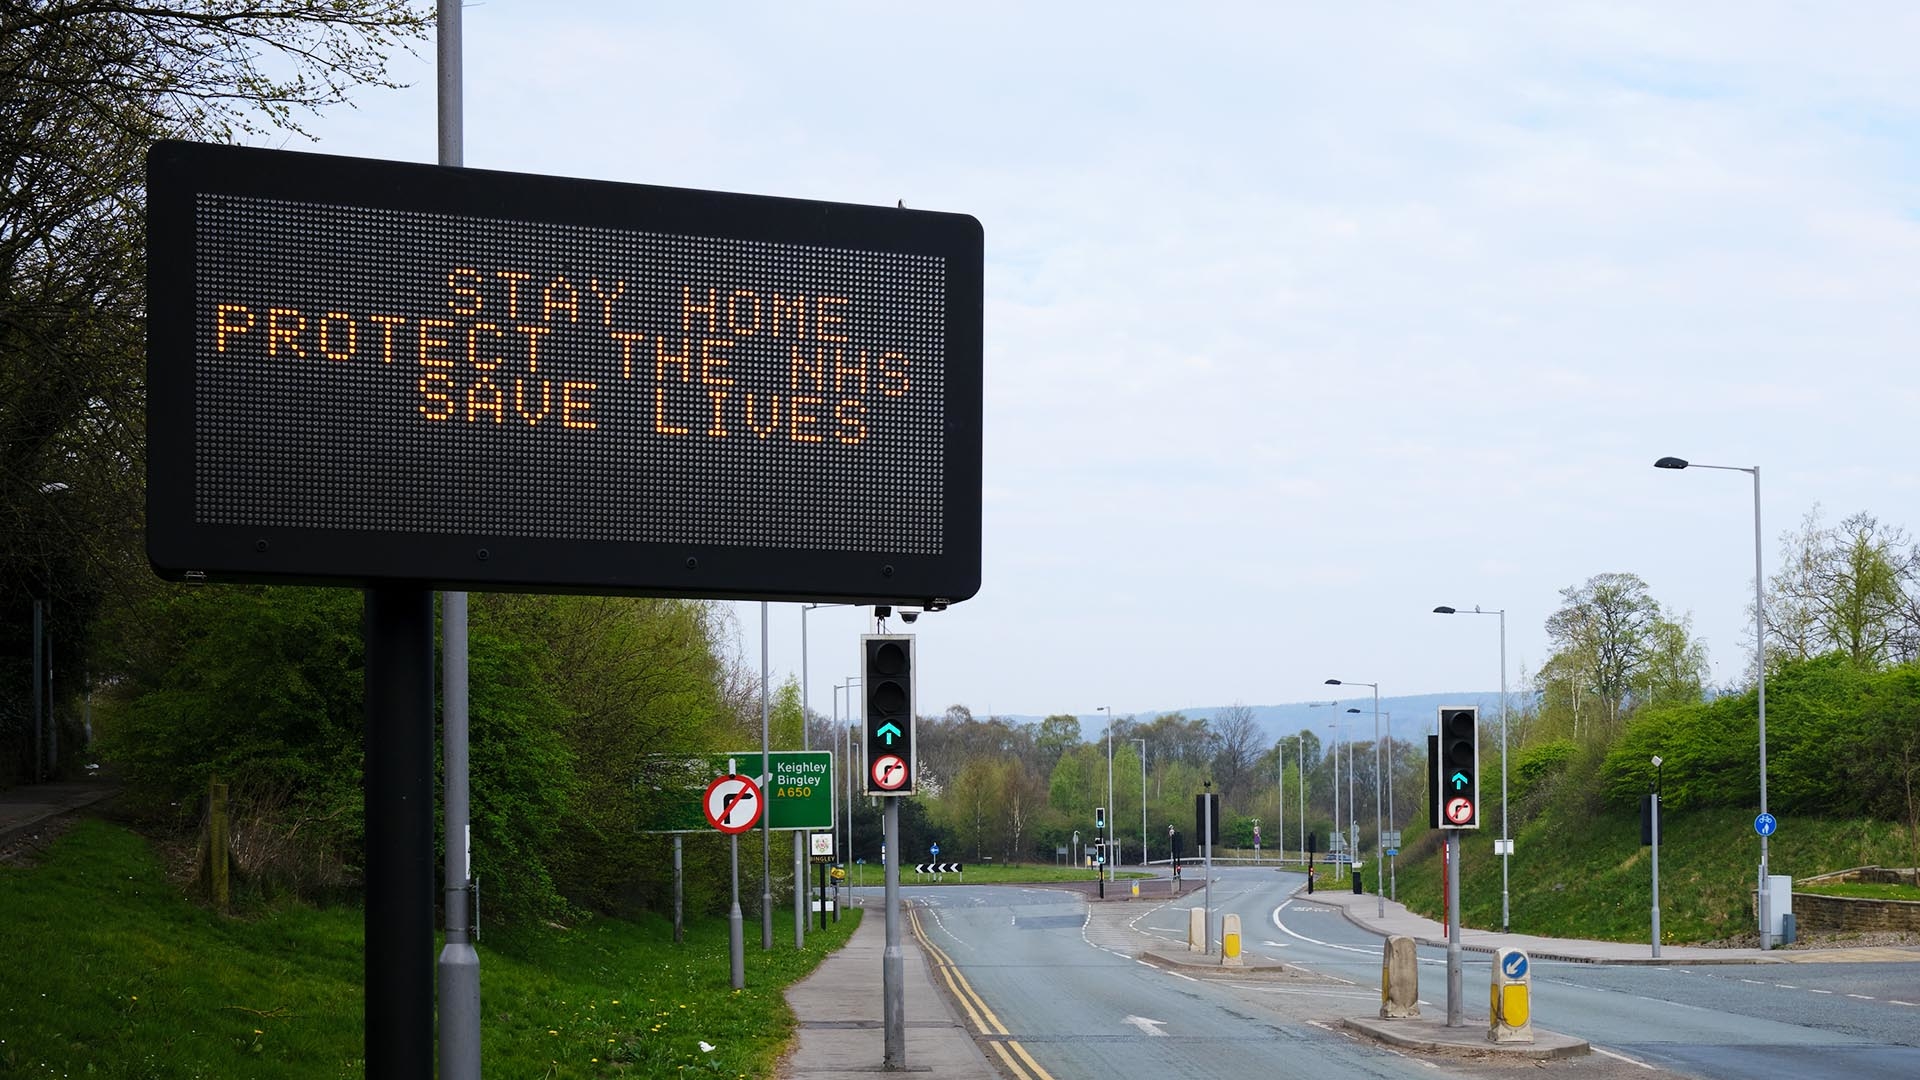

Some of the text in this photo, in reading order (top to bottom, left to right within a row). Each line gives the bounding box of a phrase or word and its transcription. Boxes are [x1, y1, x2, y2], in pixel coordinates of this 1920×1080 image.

[449, 268, 848, 343] STAY HOME
[217, 304, 911, 397] PROTECT THE NHS
[419, 374, 867, 444] SAVE LIVES
[777, 762, 827, 774] Keighley
[777, 775, 821, 787] Bingley
